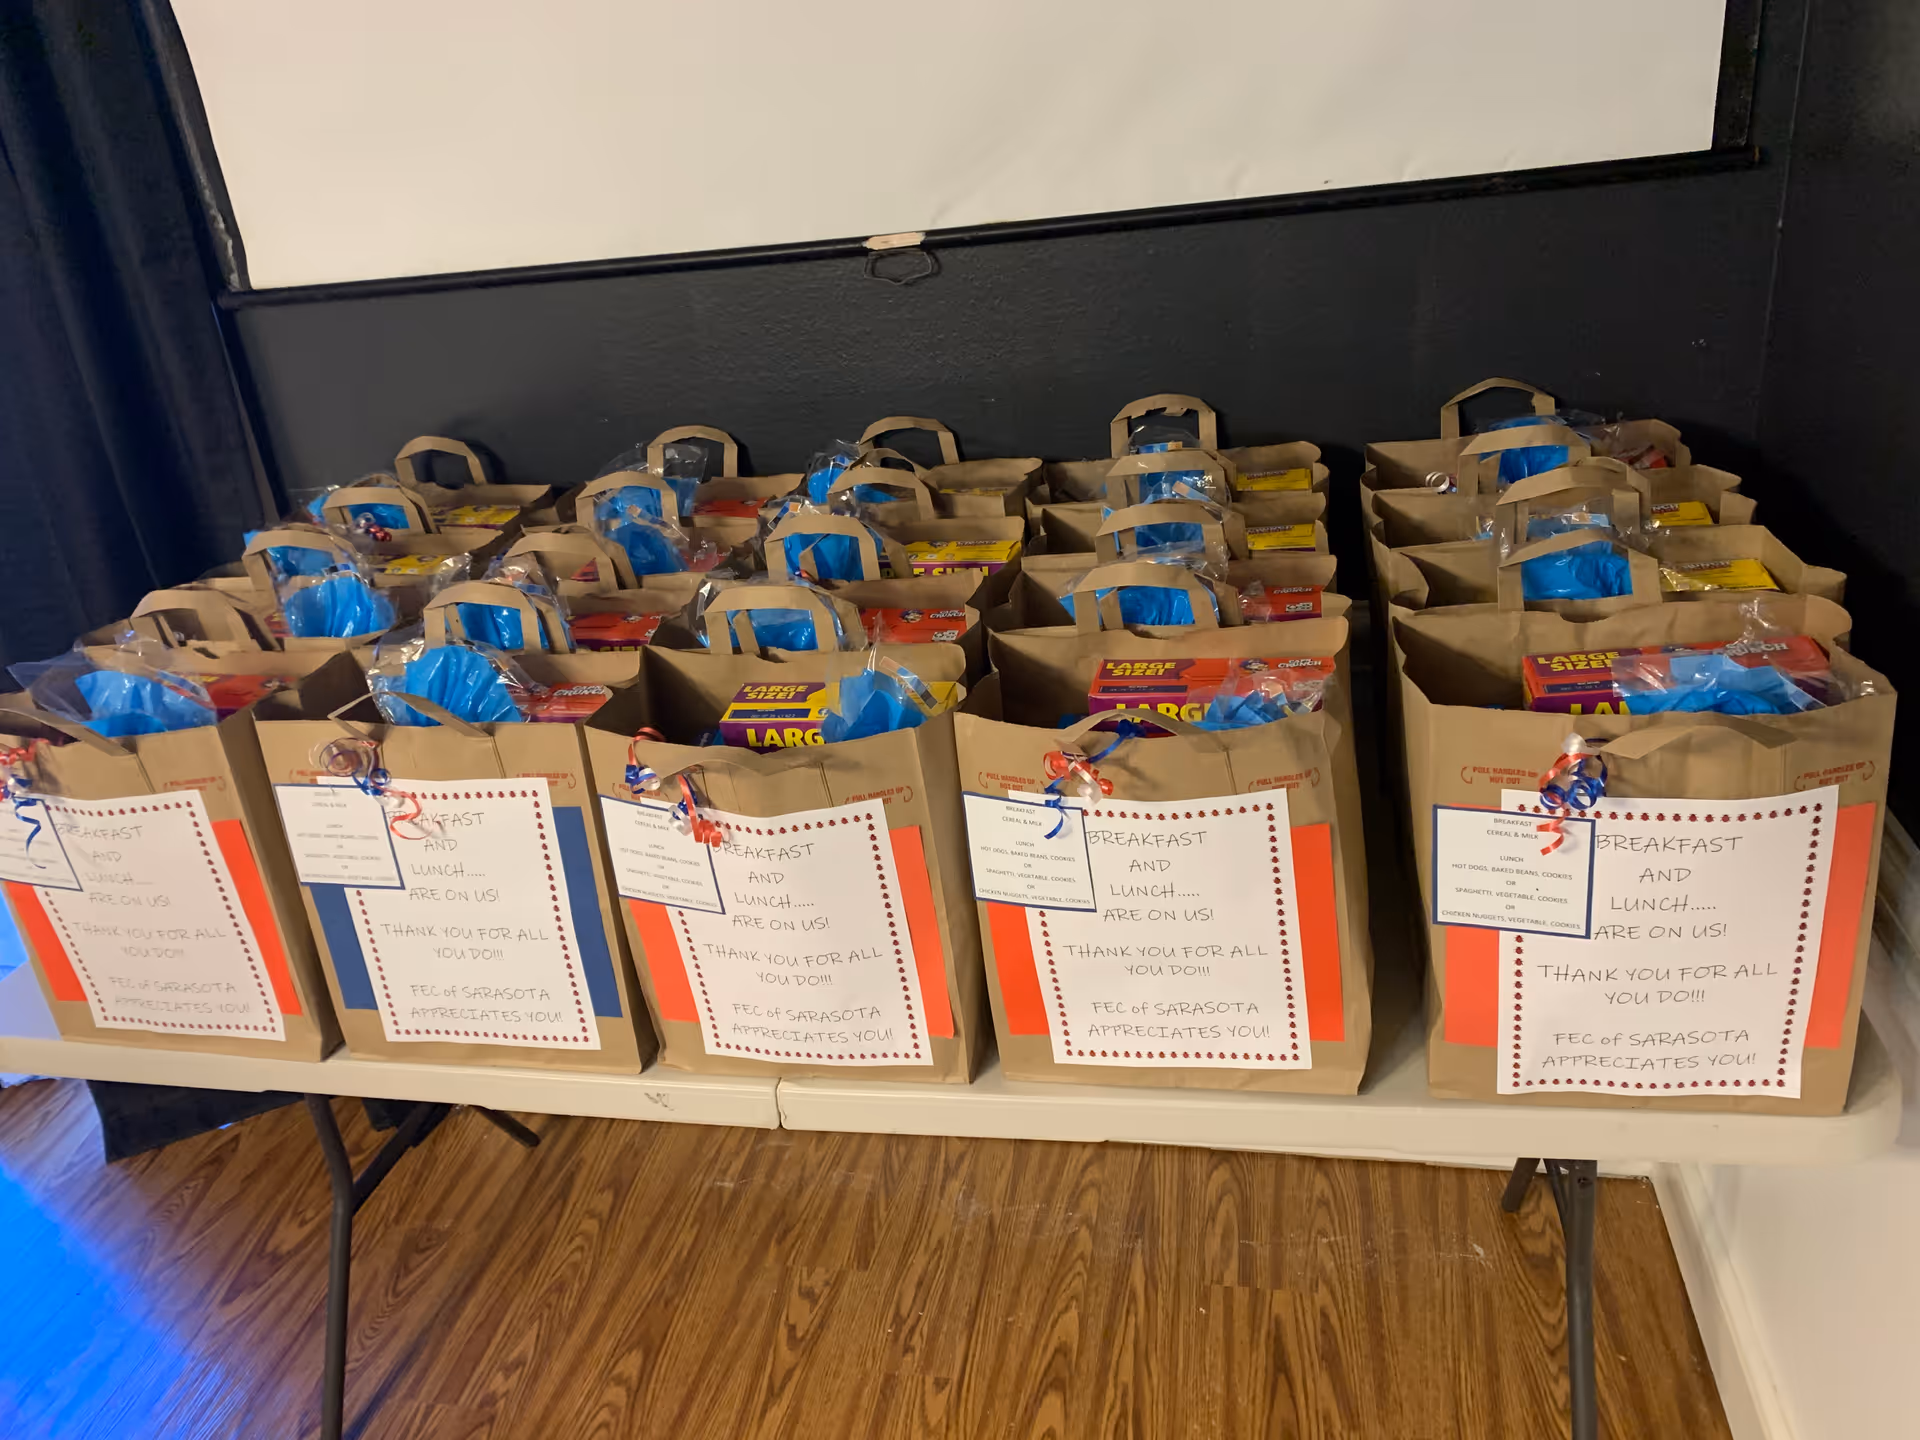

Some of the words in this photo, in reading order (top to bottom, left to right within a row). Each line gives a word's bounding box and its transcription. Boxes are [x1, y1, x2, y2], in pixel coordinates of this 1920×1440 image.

[1537, 651, 1619, 665] LARGE
[1112, 668, 1166, 676] SIZE!
[743, 685, 808, 693] LARGE
[746, 691, 796, 700] SIZE!
[746, 728, 825, 748] LARG
[1493, 768, 1526, 776] HANDLES
[385, 811, 484, 827] AKFAST
[1494, 818, 1533, 826] BREAKFAST
[423, 839, 457, 851] AND
[1085, 830, 1207, 848] BREAKFAST
[1595, 834, 1743, 853] BREAKFAST
[1129, 860, 1170, 872] AND
[748, 871, 784, 884] AND
[1542, 872, 1572, 880] COOKIES
[1639, 868, 1691, 883] AND
[409, 888, 440, 900] ARE
[446, 889, 468, 901] ON
[475, 889, 499, 902] US!
[1103, 909, 1141, 921] ARE
[1148, 910, 1176, 920] ON
[1185, 908, 1213, 921] US!
[732, 915, 764, 929] ARE
[770, 920, 795, 930] ON
[802, 917, 830, 930] US!
[1550, 921, 1580, 929] COOKIES
[380, 923, 437, 937] THANK
[440, 927, 472, 939] YOU
[478, 928, 512, 940] FOR
[517, 929, 548, 941] ALL
[1594, 925, 1640, 940] ARE
[1649, 926, 1681, 938] ON
[1693, 923, 1726, 938] US!
[433, 948, 465, 959] YOU
[471, 949, 504, 960] DO!!!
[703, 944, 760, 961] THANK
[764, 954, 799, 966] YOU
[805, 953, 843, 966] FOR
[848, 948, 882, 963] ALL
[1063, 944, 1130, 958] THANK
[1137, 947, 1175, 957] YOU
[1182, 945, 1224, 958] FOR
[1230, 945, 1267, 957] ALL
[1125, 965, 1163, 976] YOU
[1169, 965, 1210, 976] DO!!!
[1537, 964, 1617, 982] THANK
[1626, 968, 1669, 981] YOU
[1680, 965, 1727, 980] FOR
[1734, 963, 1777, 978] ALL
[756, 972, 789, 985] YOU
[793, 975, 832, 986] DO!!!
[410, 985, 439, 996] FEC
[444, 986, 456, 997] of
[462, 987, 550, 1000] SARASOTA
[1605, 992, 1648, 1004] YOU
[1657, 990, 1704, 1003] DO!!!
[410, 1007, 521, 1022] APPRECIATES
[525, 1012, 561, 1023] YOU!
[732, 1004, 762, 1016] FEC
[767, 1007, 780, 1020] of
[787, 1006, 881, 1023] SARASOTA
[1092, 1002, 1125, 1013] FEC
[1132, 1002, 1148, 1015] of
[1154, 1002, 1259, 1016] SARASOTA
[732, 1025, 848, 1044] APPRECIATES
[853, 1028, 893, 1042] YOU!
[1088, 1024, 1221, 1039] APPRECIATES
[1227, 1025, 1269, 1038] YOU!
[1553, 1033, 1593, 1045] FEC
[1601, 1033, 1623, 1046] of
[1630, 1030, 1748, 1047] SARASOTA
[1542, 1055, 1699, 1070] APPRECIATES
[1708, 1053, 1755, 1066] YOU!
